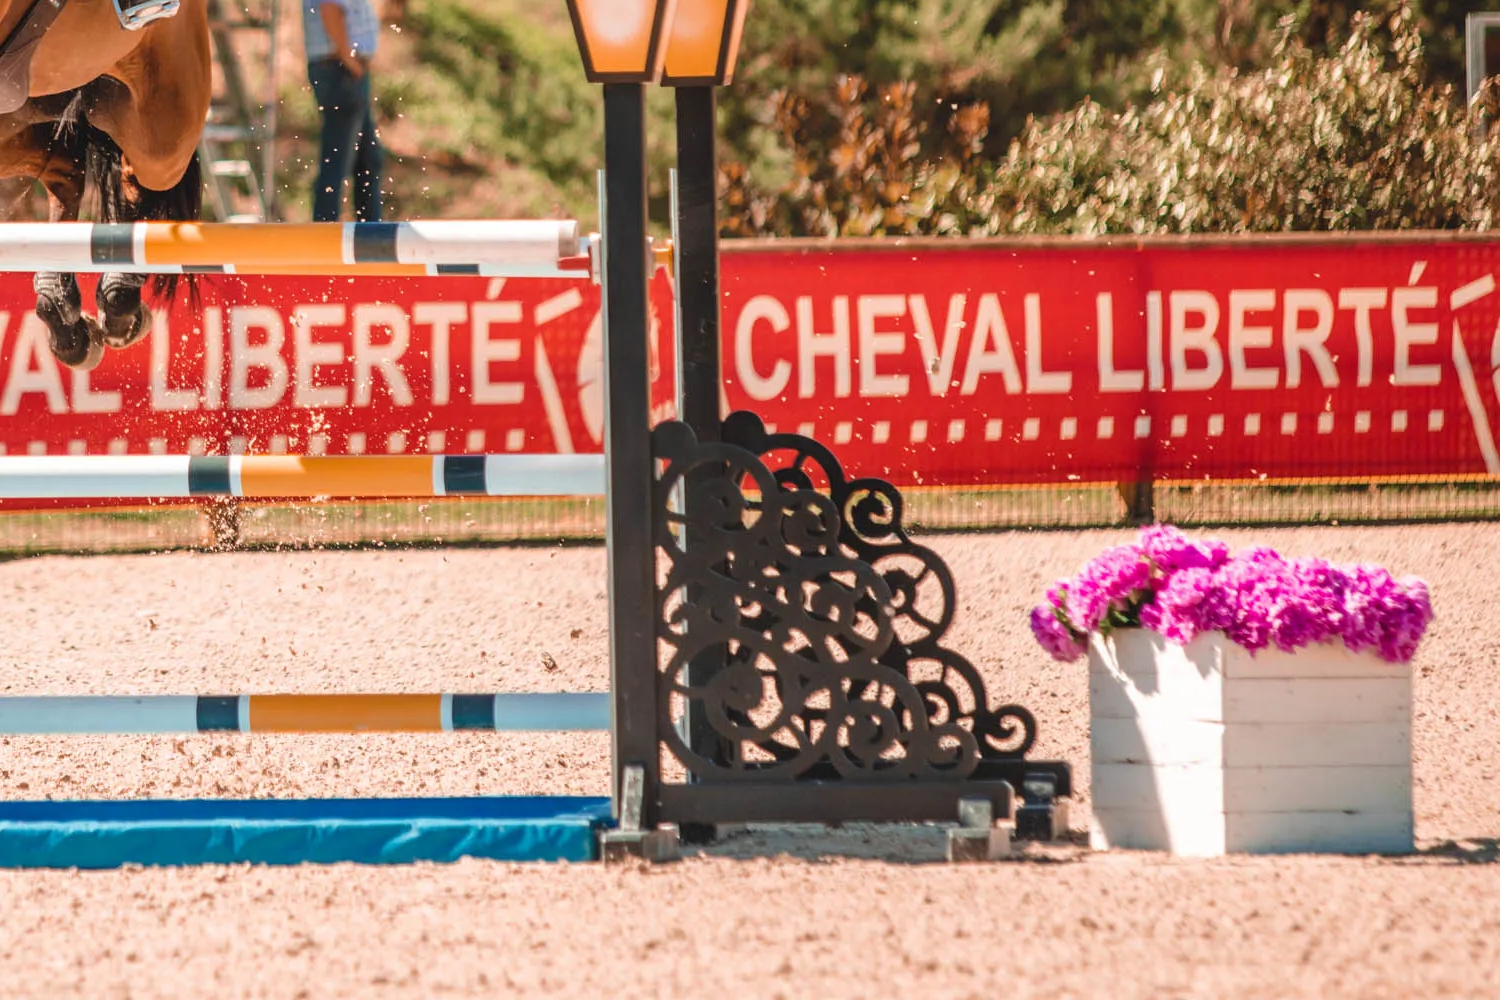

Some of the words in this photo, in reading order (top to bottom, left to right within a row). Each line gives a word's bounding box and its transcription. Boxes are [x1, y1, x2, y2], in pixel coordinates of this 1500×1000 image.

[150, 278, 525, 412] LIBERTÉ
[735, 291, 1073, 401] CHEVAL
[1097, 261, 1443, 393] LIBERTÉ
